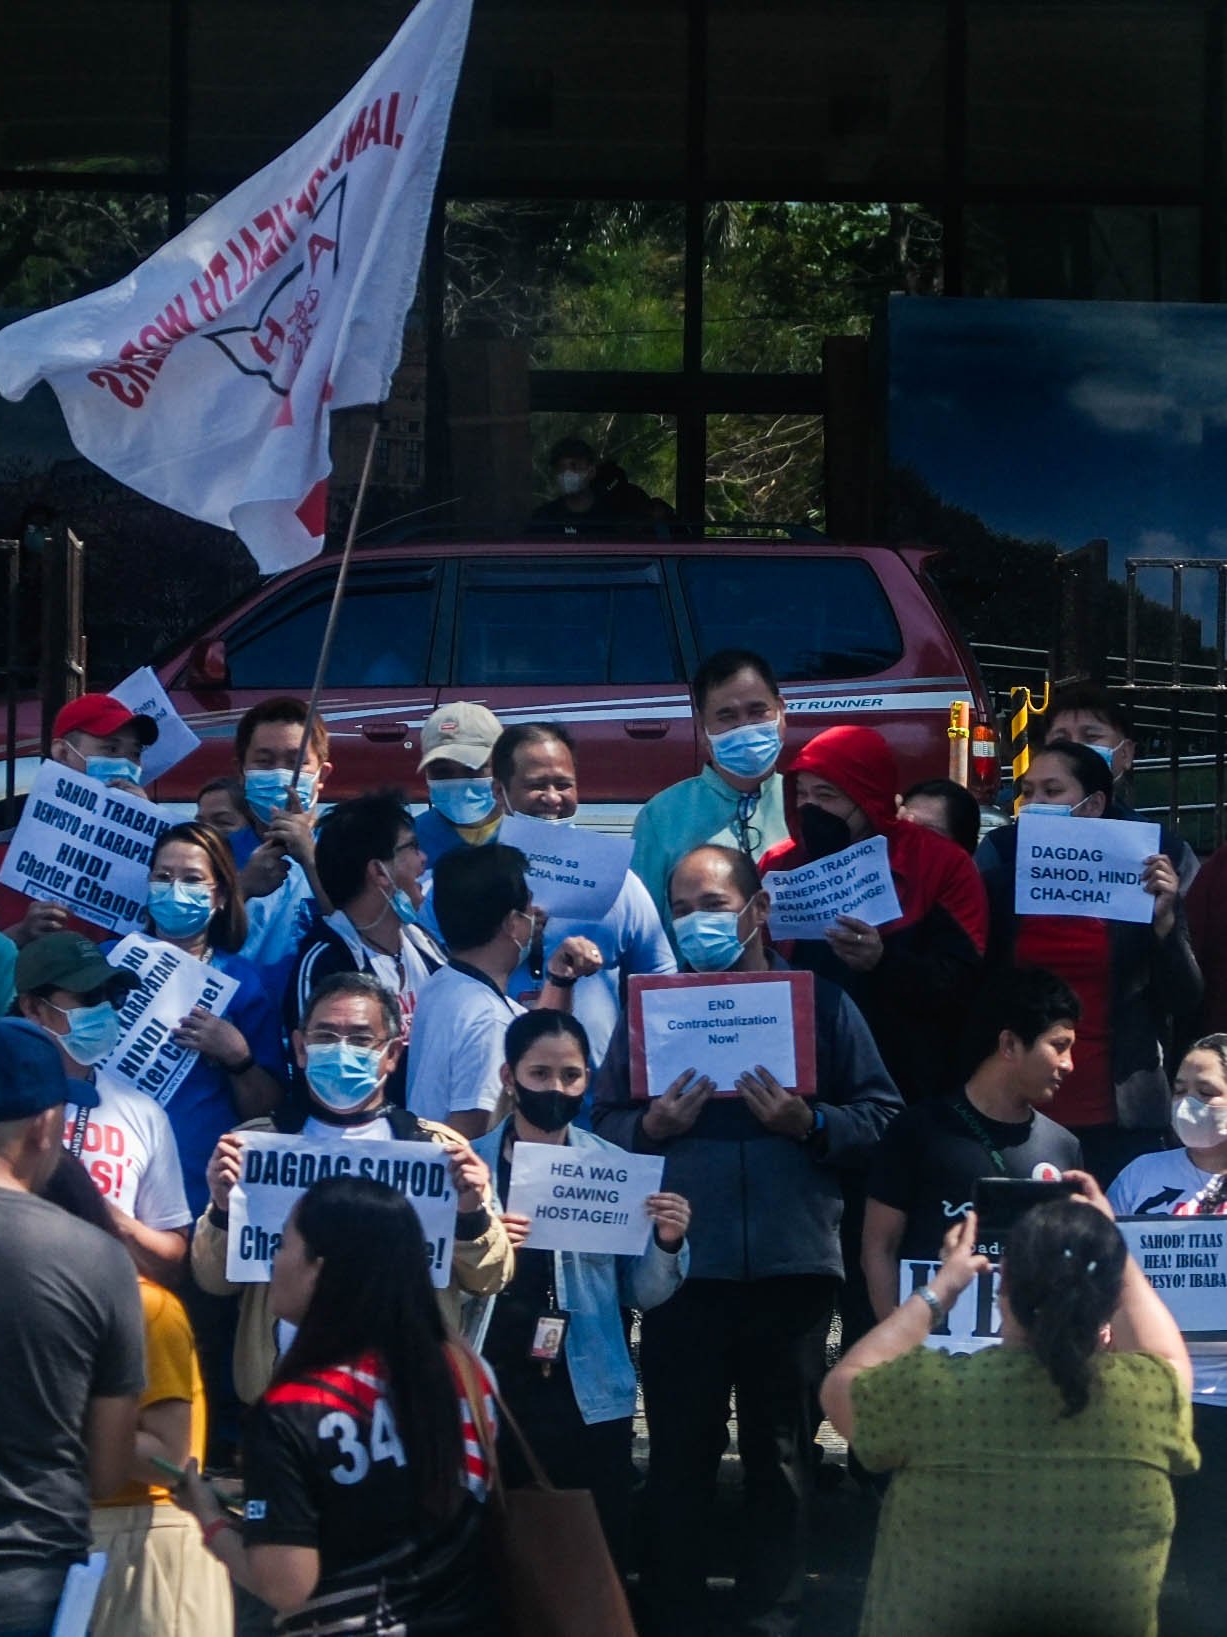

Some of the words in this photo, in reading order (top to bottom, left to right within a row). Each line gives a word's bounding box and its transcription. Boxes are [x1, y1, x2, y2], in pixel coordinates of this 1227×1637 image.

[808, 698, 883, 710] RUNNER
[54, 777, 99, 815] SAHOD,
[102, 797, 173, 839] TRABAH
[79, 822, 96, 841] at
[55, 842, 112, 881] HINDI
[529, 852, 563, 866] pondo
[565, 859, 579, 869] sa
[1031, 845, 1103, 862] DAGDAG
[16, 850, 74, 893] Charter
[773, 869, 819, 886] SAHOD,
[820, 844, 876, 874] TRABAHO,
[582, 878, 597, 888] sa
[775, 874, 844, 901] BENEPISYO
[845, 867, 858, 881] AT
[1030, 867, 1094, 884] SAHOD,
[1030, 887, 1111, 904] CHA-CHA!
[780, 907, 839, 924] CHARTER
[708, 999, 735, 1011] END
[667, 1014, 778, 1031] Contractualization
[708, 1032, 740, 1045] Now!
[116, 1017, 169, 1079] HINDI
[551, 1163, 584, 1178] HEA
[589, 1166, 628, 1182] WAG
[552, 1185, 620, 1203] GAWING
[535, 1205, 629, 1225] HOSTAGE!!!
[1140, 1233, 1185, 1250] SAHOD!
[1188, 1233, 1223, 1248] ITAAS
[1143, 1253, 1172, 1269] HEA!
[1175, 1252, 1220, 1268] IBIGAY
[1189, 1272, 1227, 1288] IBABA
[318, 1397, 407, 1486] 34
